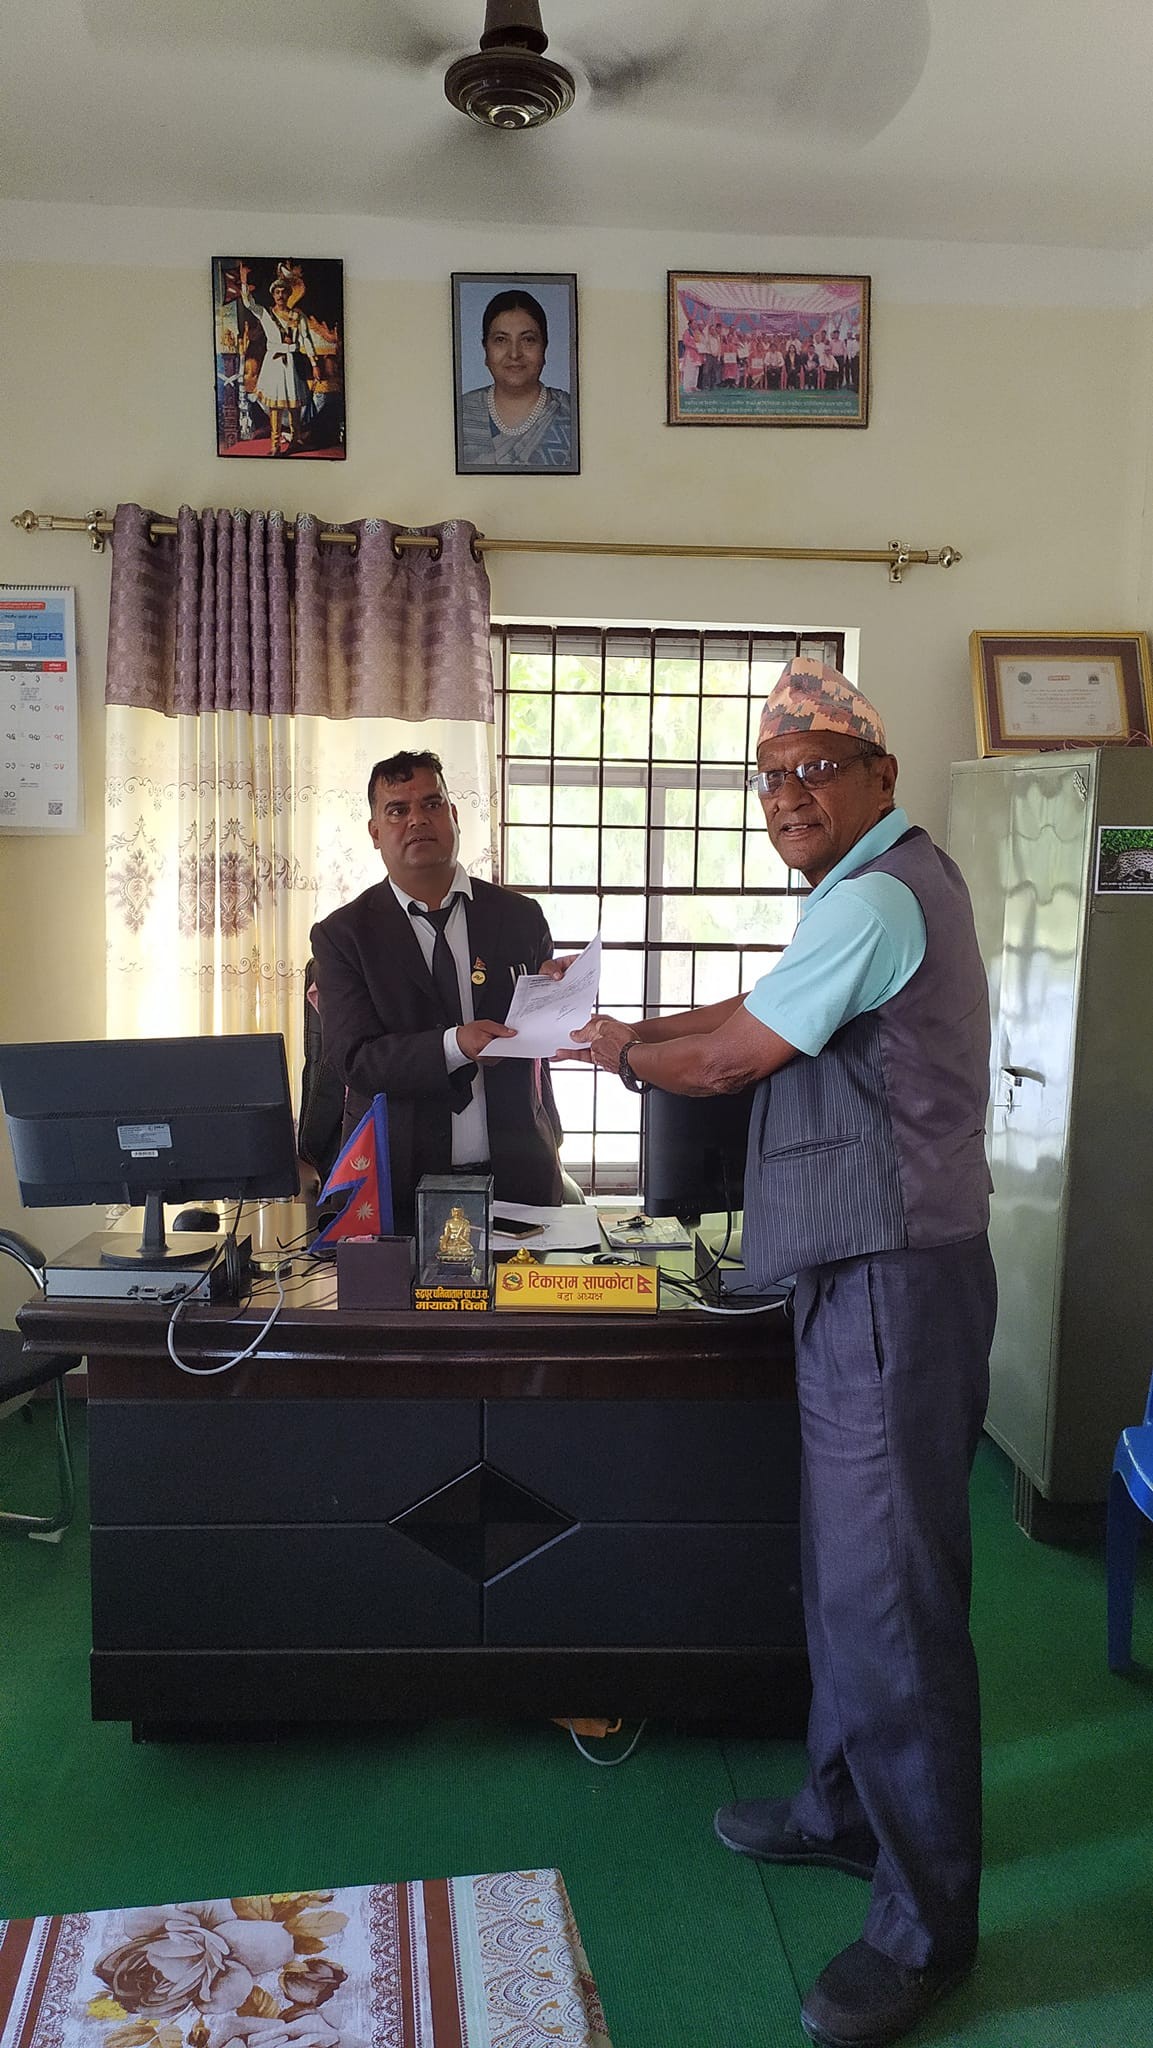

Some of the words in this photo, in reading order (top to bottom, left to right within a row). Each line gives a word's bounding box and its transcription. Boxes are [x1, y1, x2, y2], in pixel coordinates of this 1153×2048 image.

[29, 704, 41, 712] १०
[3, 790, 16, 798] ३०
[528, 1270, 578, 1290] टिकाराम
[582, 1272, 634, 1290] सापकोटा
[556, 1292, 573, 1302] वडा
[577, 1292, 603, 1301] अध्यक्ष
[415, 1299, 458, 1310] मायाको
[460, 1299, 488, 1311] चिनो
